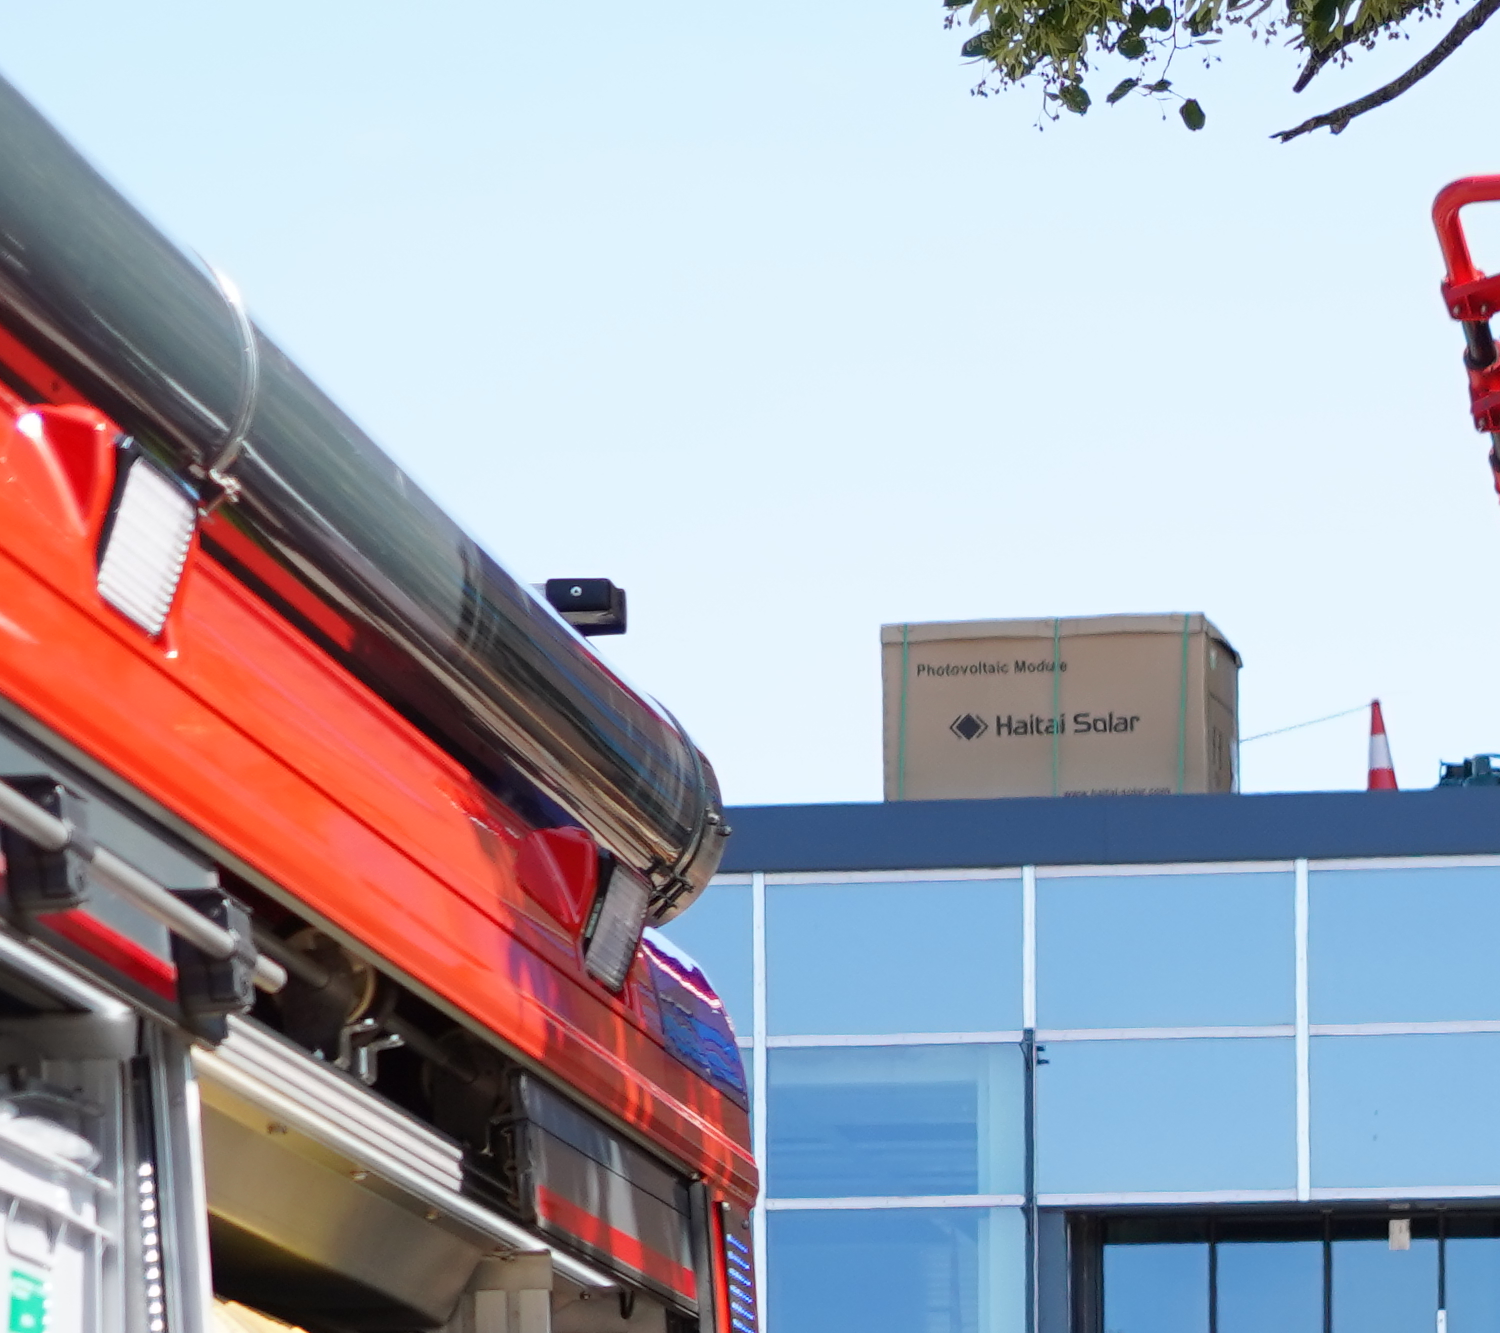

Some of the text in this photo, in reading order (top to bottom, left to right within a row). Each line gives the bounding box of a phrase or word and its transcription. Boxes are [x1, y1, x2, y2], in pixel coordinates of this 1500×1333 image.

[916, 658, 1069, 678] Photovoltaic Modue
[995, 710, 1141, 737] Haitai Solar
